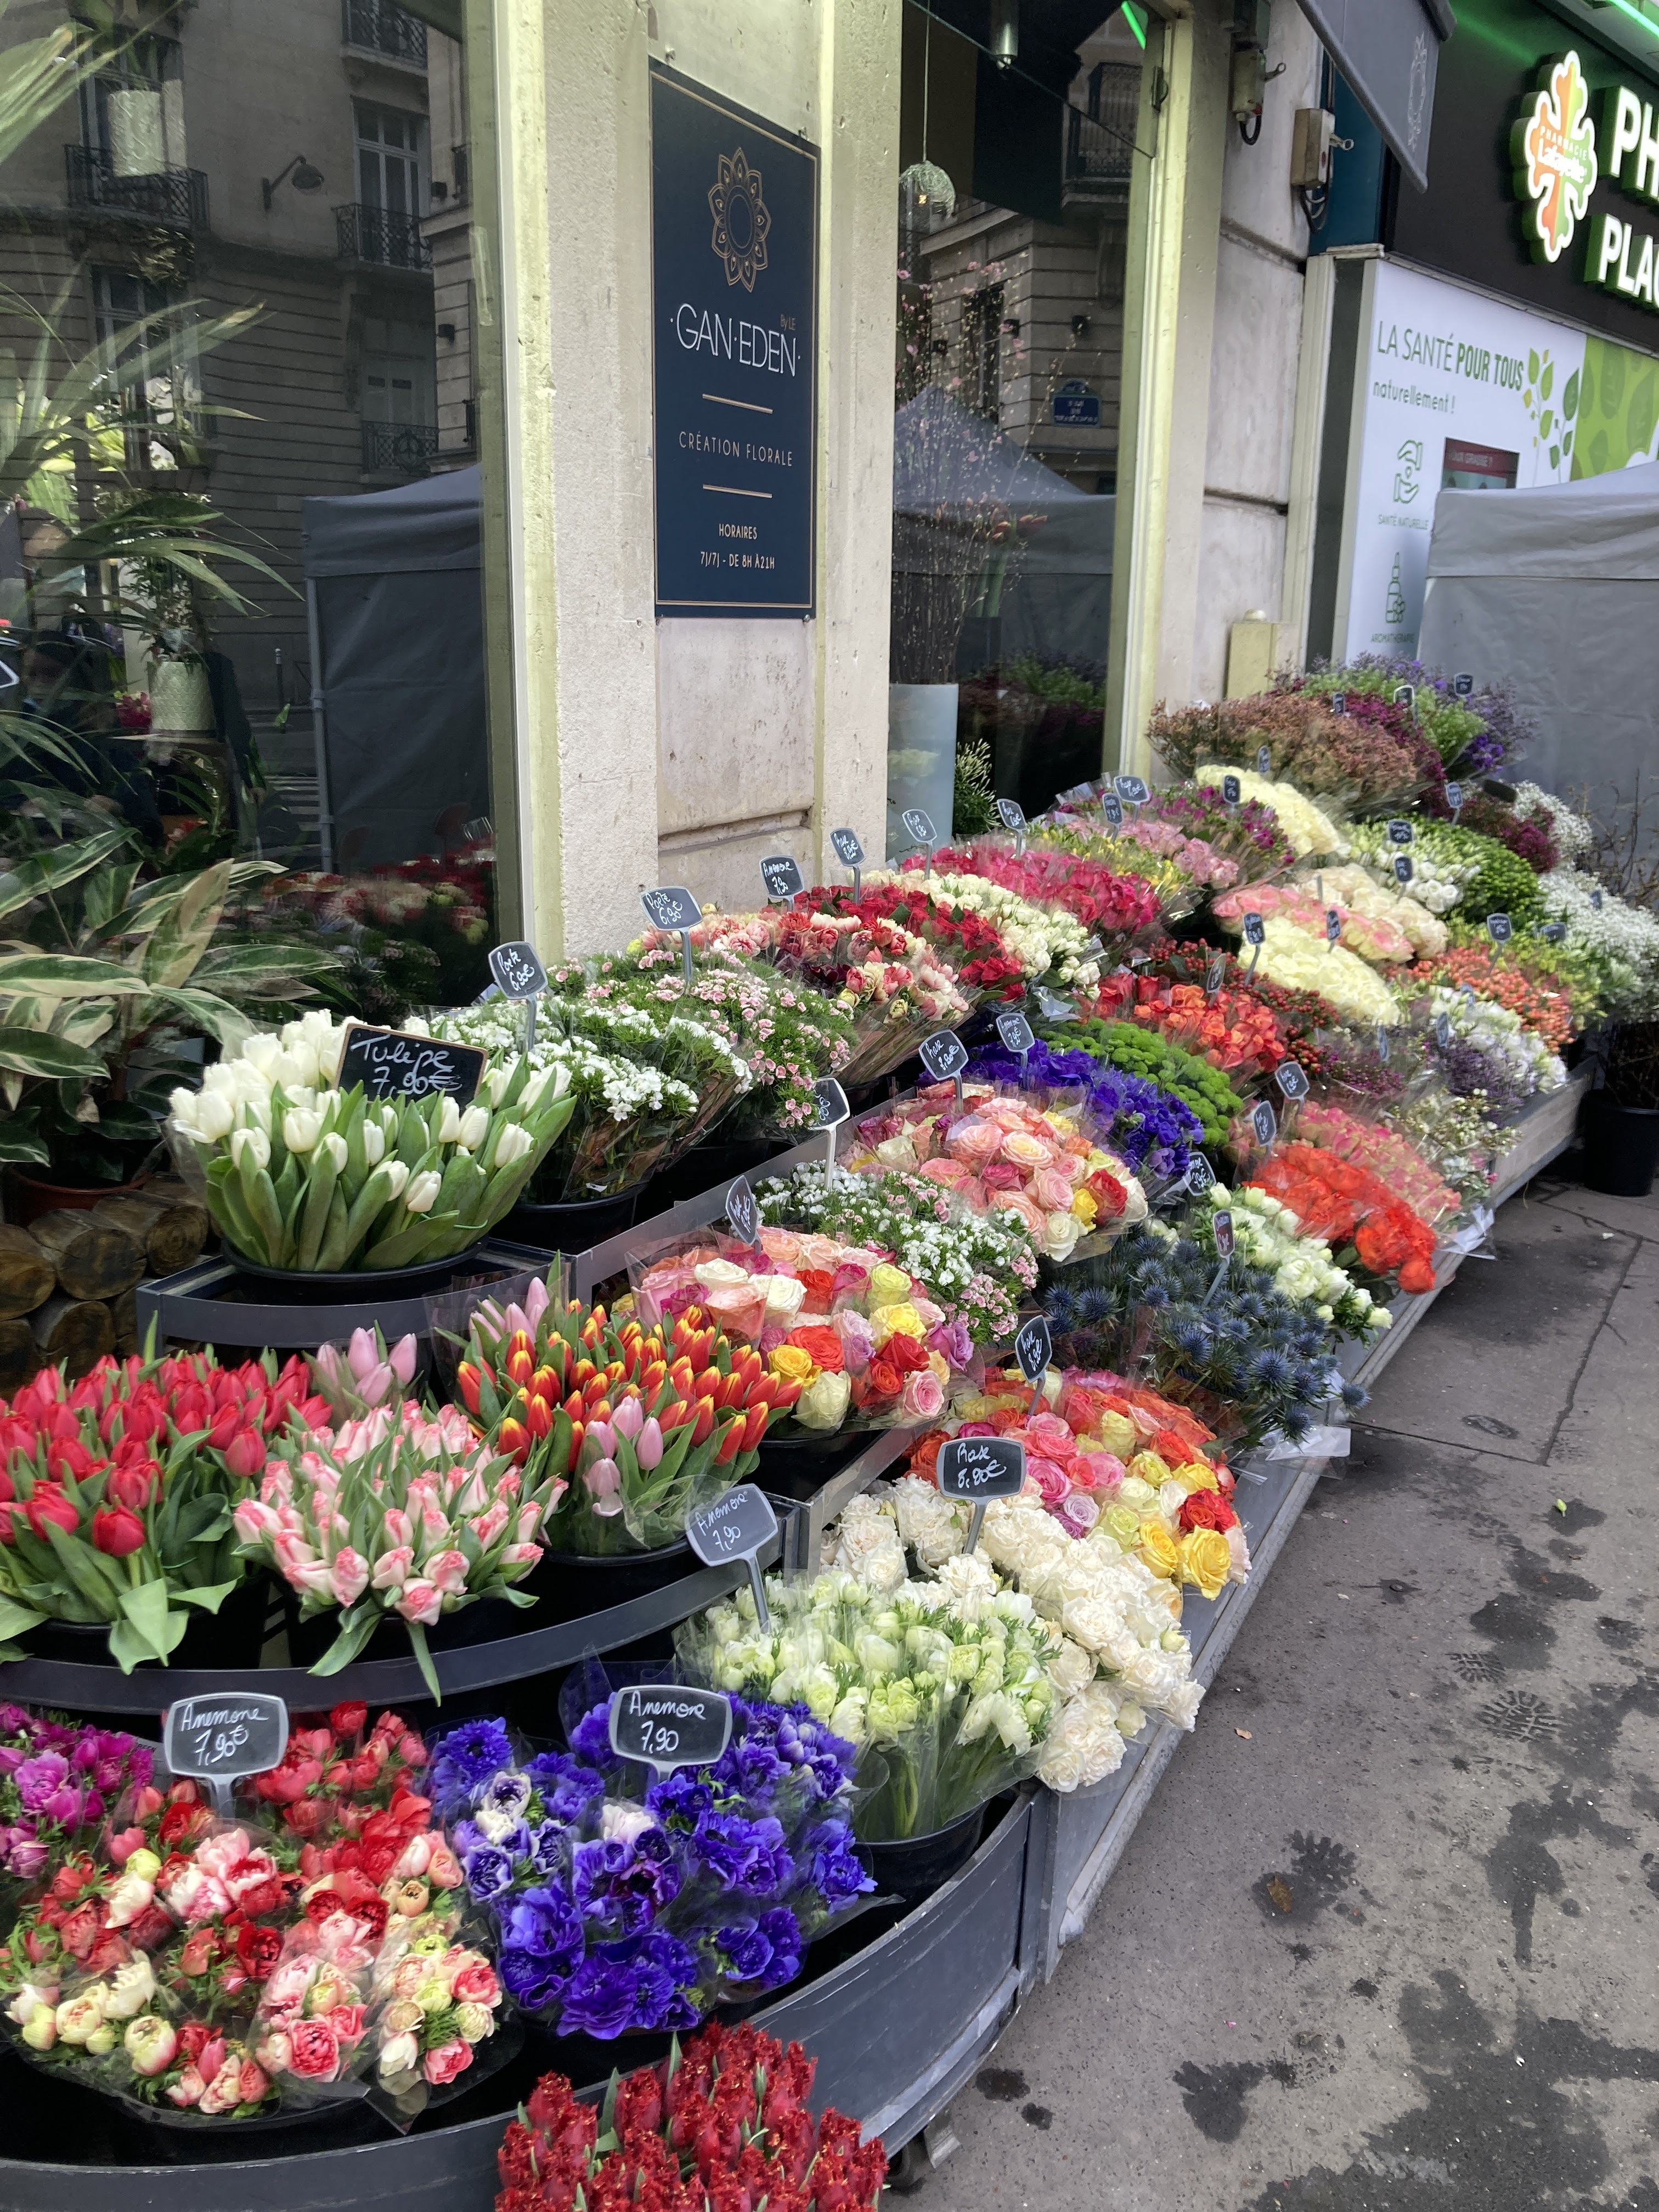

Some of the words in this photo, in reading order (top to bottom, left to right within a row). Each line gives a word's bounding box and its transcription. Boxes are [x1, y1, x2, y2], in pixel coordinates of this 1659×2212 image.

[1539, 126, 1587, 161] PHARMACIE
[1377, 320, 1398, 358] LA
[1402, 332, 1454, 372] SANTÉ
[1455, 342, 1491, 382] POUR
[1494, 353, 1524, 391] TOUS
[1373, 380, 1449, 413] naturellement
[679, 431, 740, 458] CRÉATION
[746, 443, 793, 467] FLORALE
[719, 523, 758, 540] HORAIRES
[729, 553, 740, 568] DE
[742, 554, 753, 569] 8H
[349, 1034, 455, 1071] Tulipe
[713, 1525, 741, 1551] 7,90
[180, 1702, 270, 1731] Anemone
[194, 1724, 250, 1767] 7,90€
[640, 1720, 679, 1754] 7,90
